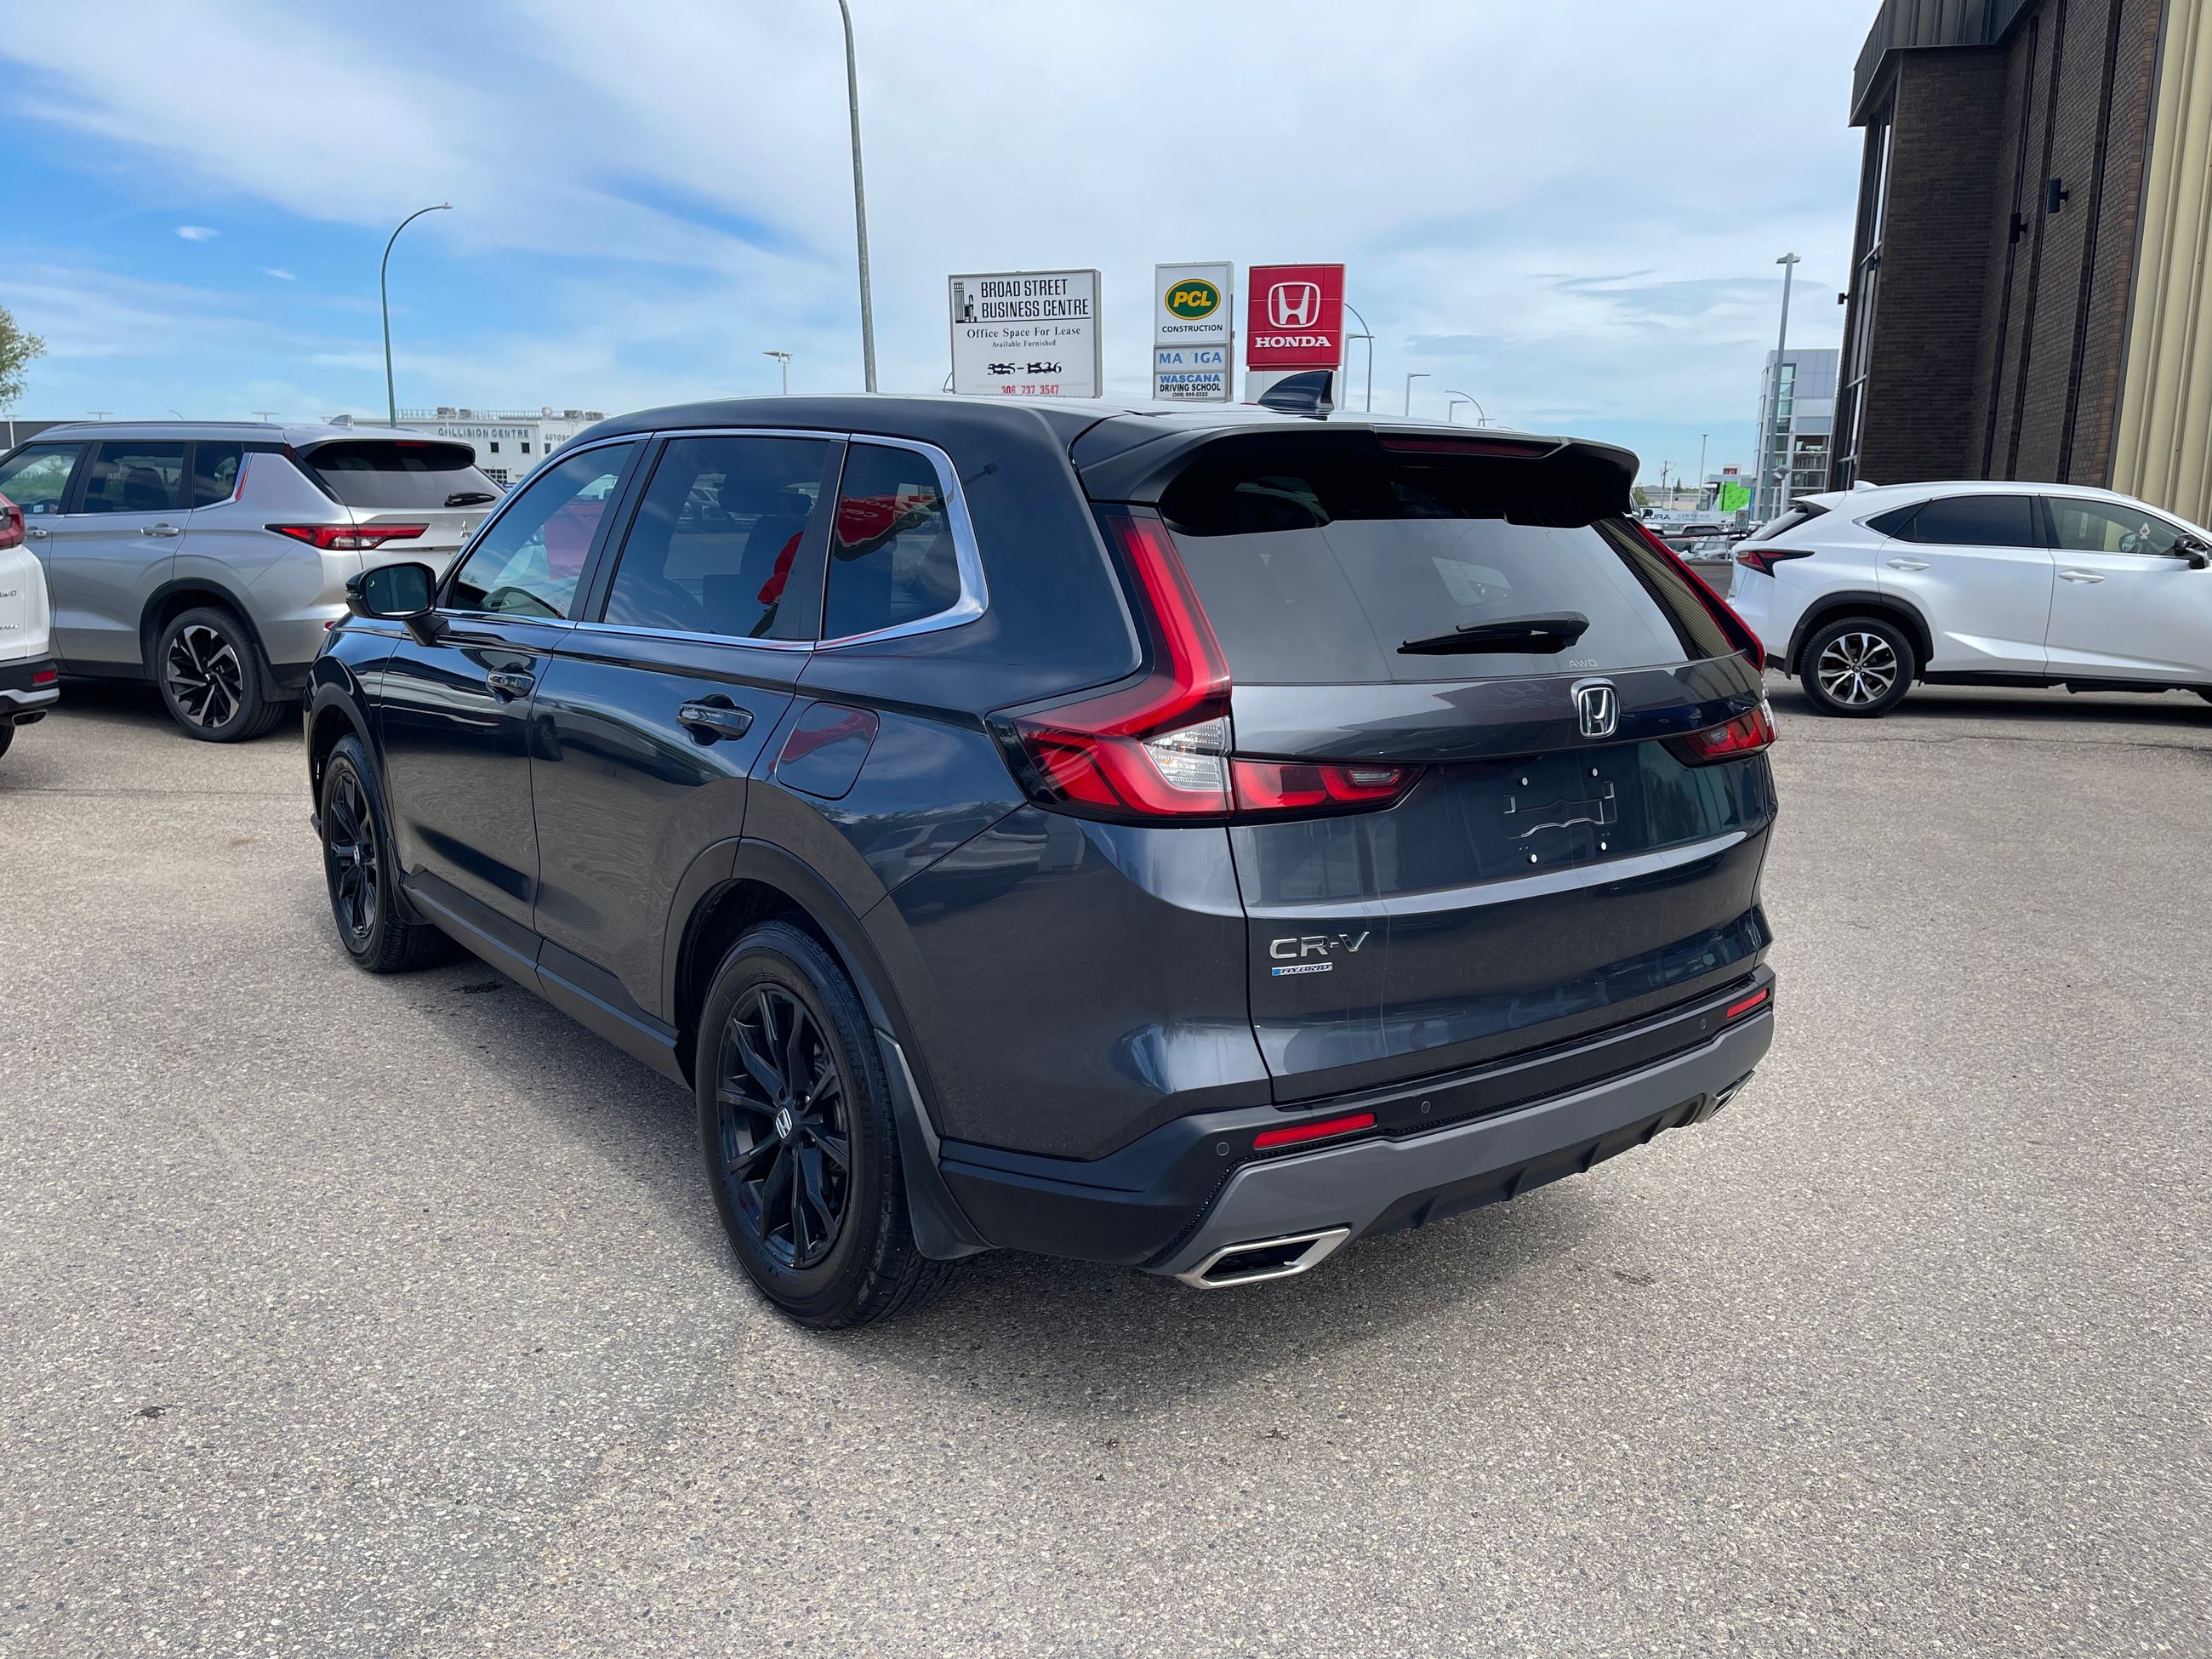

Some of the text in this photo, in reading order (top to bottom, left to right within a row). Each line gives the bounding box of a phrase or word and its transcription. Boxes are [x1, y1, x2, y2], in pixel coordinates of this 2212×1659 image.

[981, 279, 1068, 298] BROAD STREET
[1173, 290, 1211, 307] PCL
[982, 299, 1089, 318] BUSINESS CENTRE
[966, 326, 1081, 339] Office Space For Lease
[1161, 324, 1223, 333] CONSTRUCTION
[1255, 336, 1332, 348] HONDA
[1160, 373, 1221, 383] WASCANA
[1001, 385, 1059, 395] 306 737 3547
[1160, 383, 1221, 392] DRIVING SCHOOL
[492, 429, 529, 437] CENTRE
[1569, 659, 1598, 668] AWD
[1268, 931, 1370, 959] CR-V
[1280, 964, 1330, 974] HYBRID
